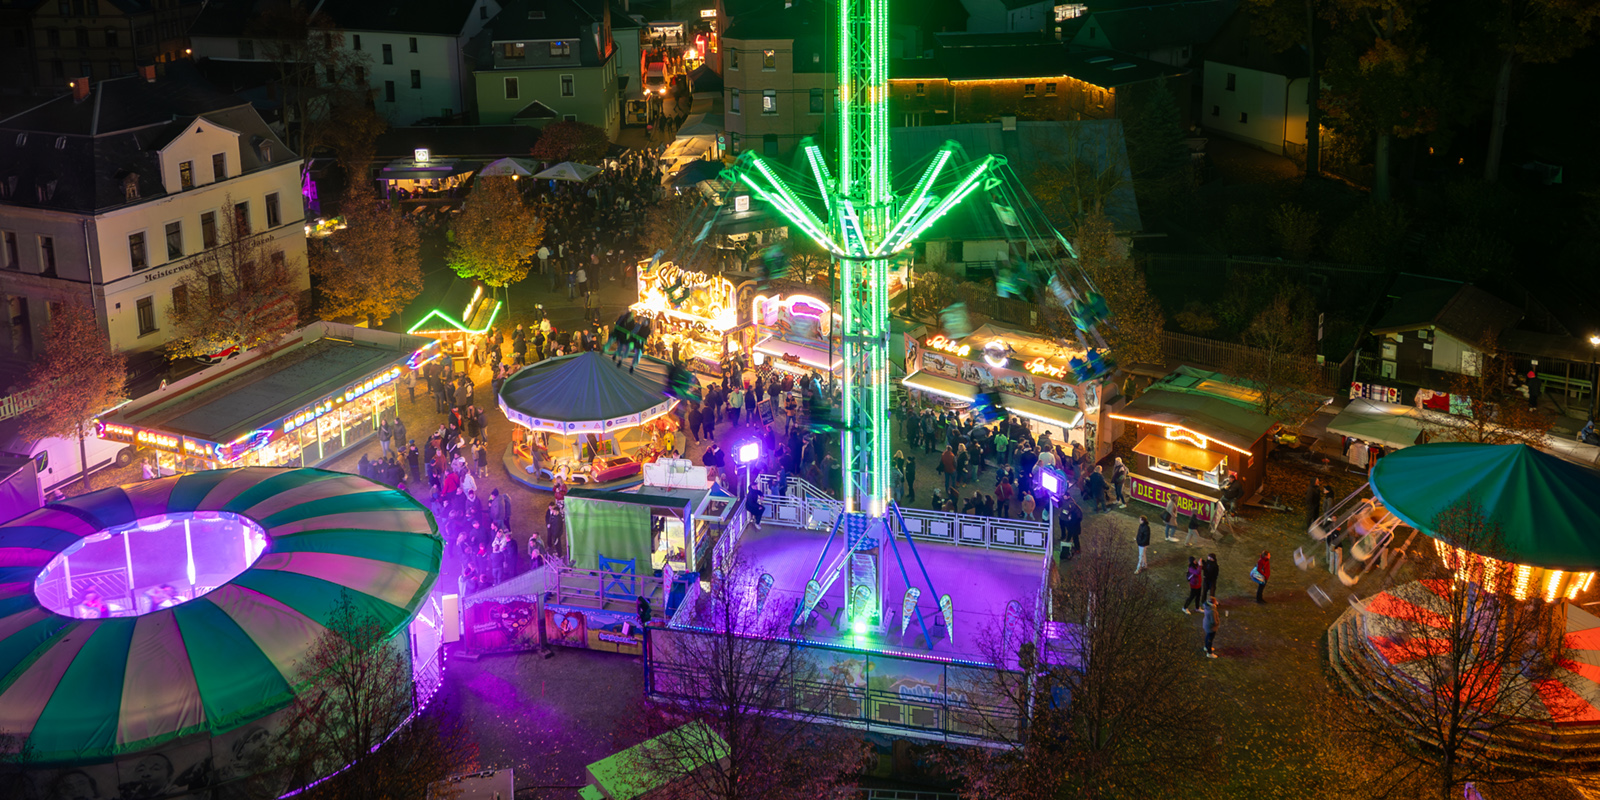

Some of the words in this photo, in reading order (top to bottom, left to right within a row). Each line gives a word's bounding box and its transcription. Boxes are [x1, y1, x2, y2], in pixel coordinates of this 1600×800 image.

[1024, 357, 1067, 379] Sport
[1137, 483, 1154, 499] DIE
[1155, 488, 1204, 516] EISABRIK
